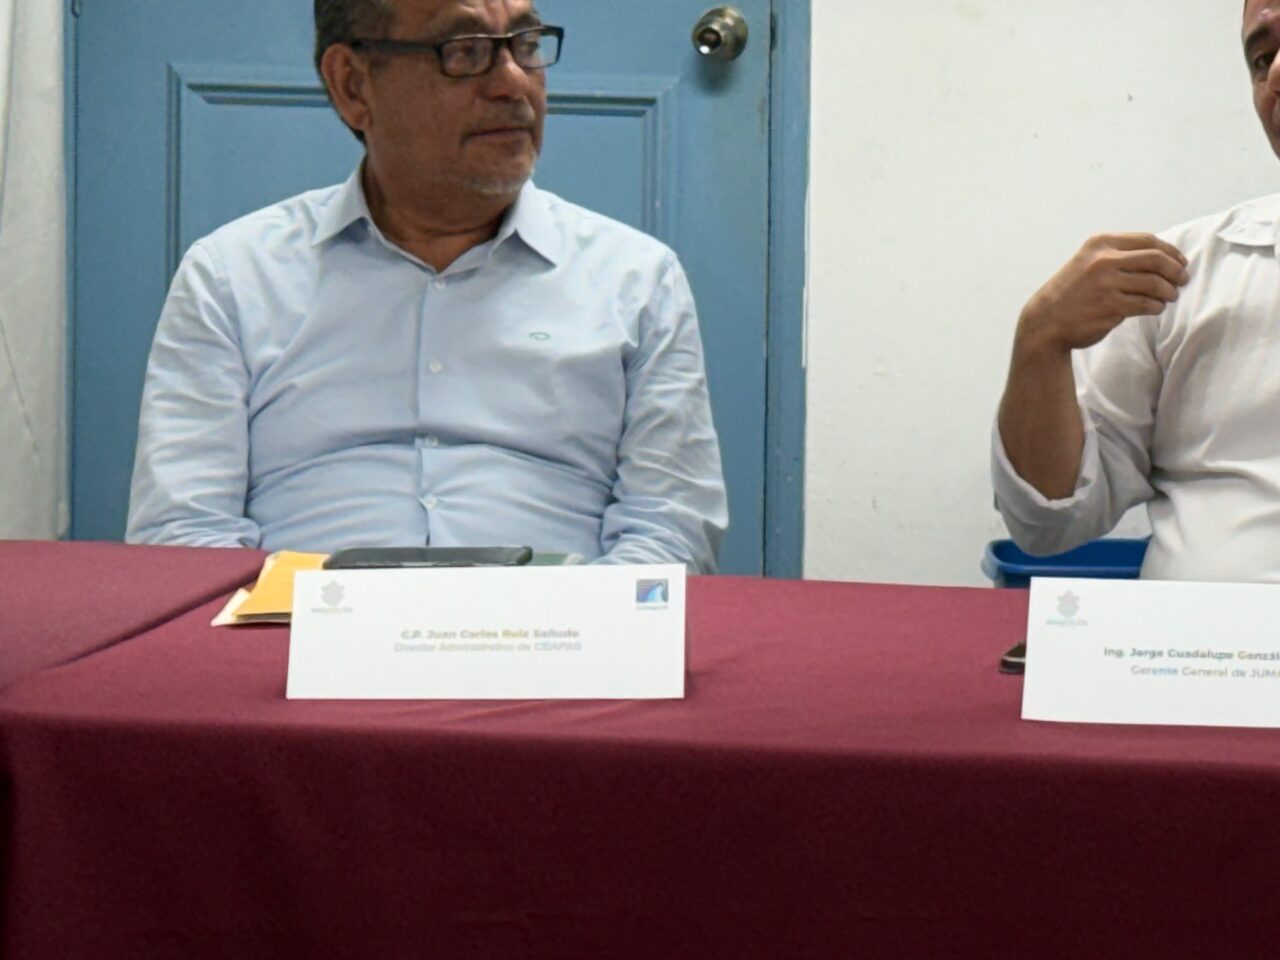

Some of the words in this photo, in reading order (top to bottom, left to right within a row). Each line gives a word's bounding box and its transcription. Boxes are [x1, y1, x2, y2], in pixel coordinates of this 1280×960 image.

[426, 629, 457, 639] Juan
[460, 628, 499, 639] Carlos
[518, 642, 532, 653] de
[1129, 648, 1164, 660] Jorge
[1167, 648, 1234, 661] Guadalupe
[1130, 665, 1179, 676] Gerente
[1182, 667, 1229, 678] General
[1231, 668, 1247, 679] de
